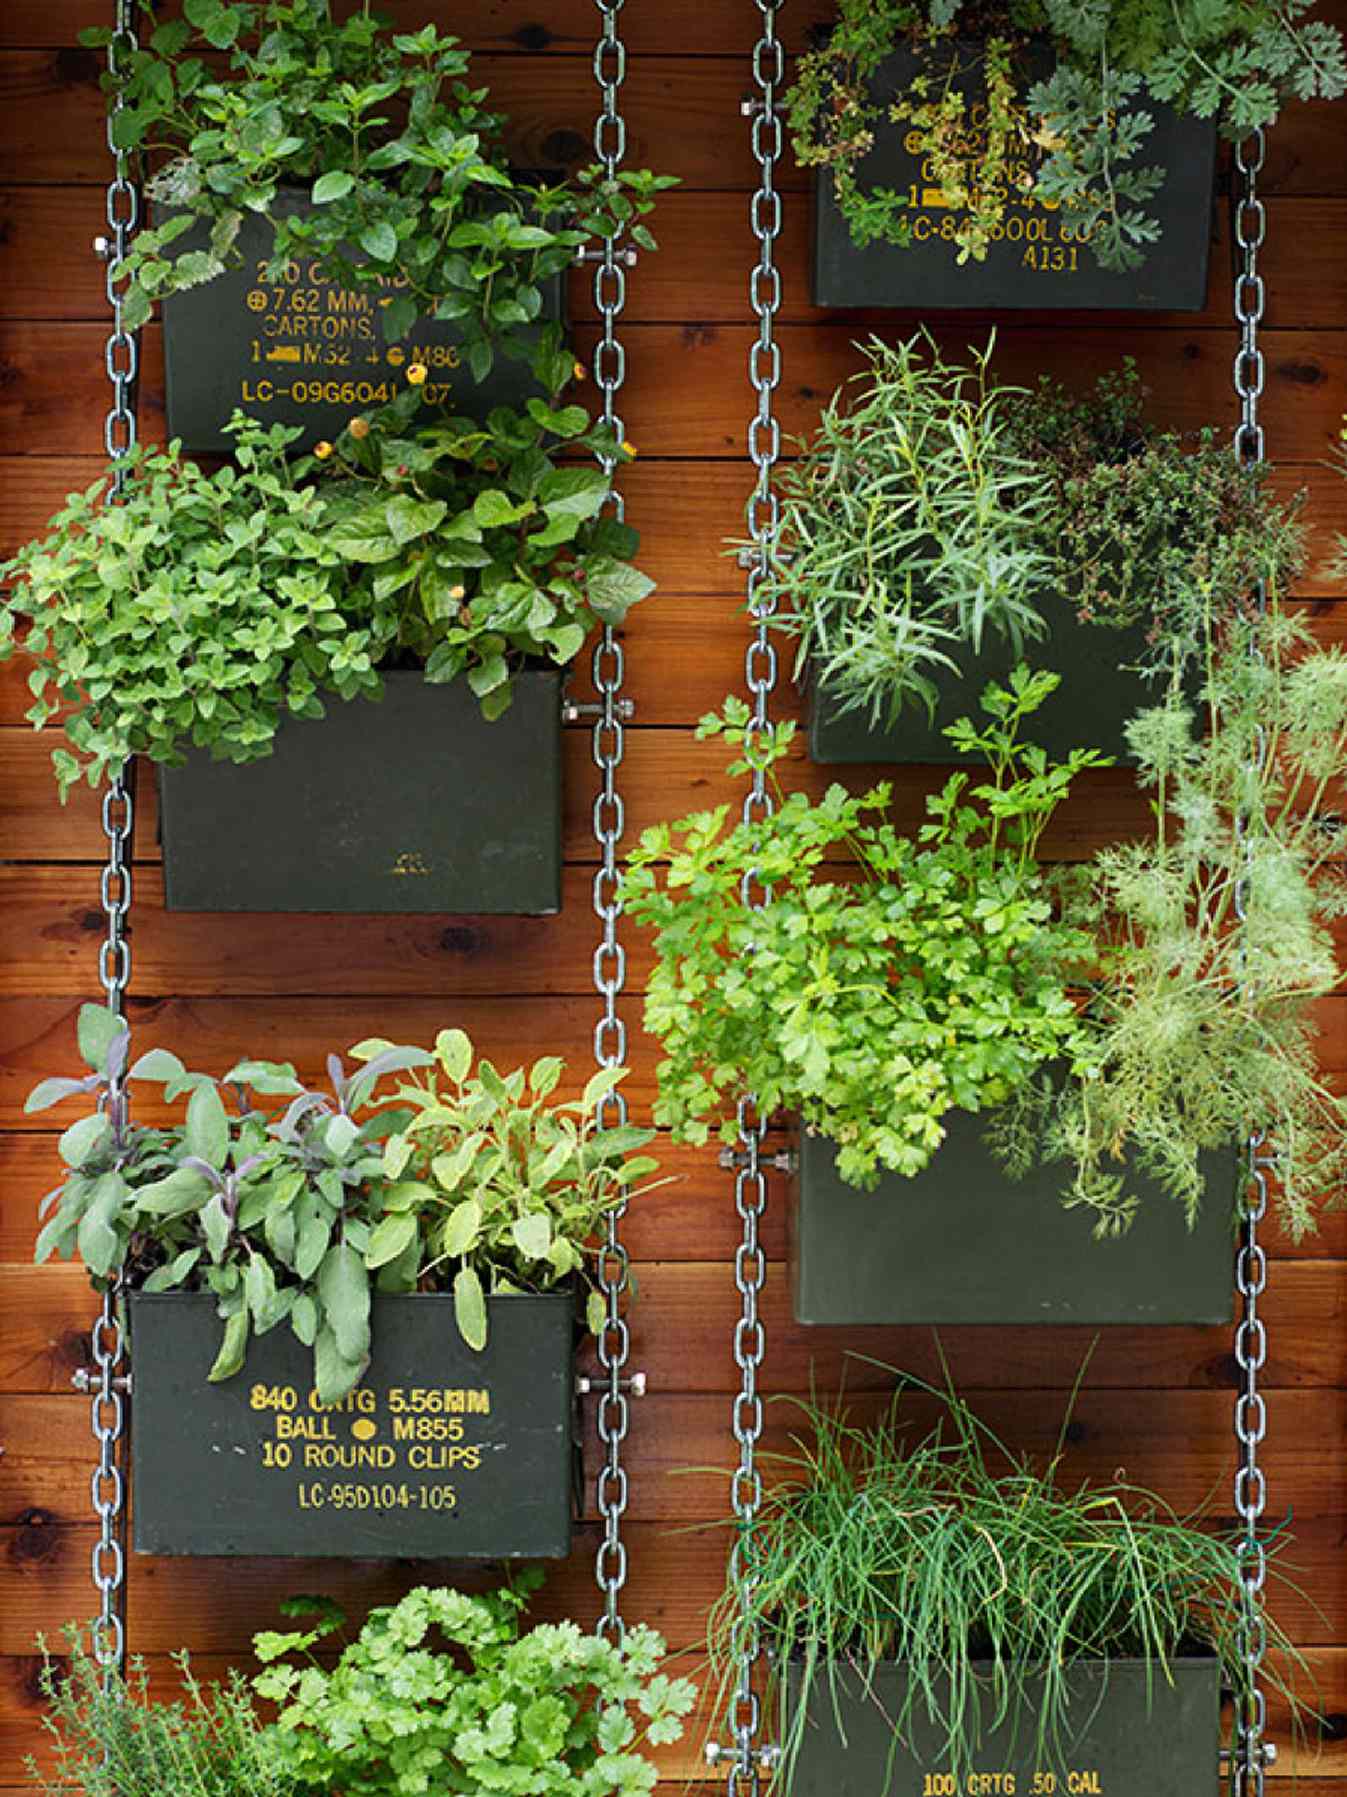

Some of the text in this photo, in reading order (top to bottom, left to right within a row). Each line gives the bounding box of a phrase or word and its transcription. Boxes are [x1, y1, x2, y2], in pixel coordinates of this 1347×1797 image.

[1023, 244, 1079, 272] A131
[256, 260, 301, 285] 20
[272, 288, 320, 312] 7.62
[251, 340, 261, 363] 1
[250, 1384, 297, 1412] 840
[276, 1415, 464, 1441] BALL M855
[262, 1443, 482, 1470] 10 ROUND CLIPS
[299, 1482, 457, 1510] LC-95D104-105
[923, 1774, 955, 1797] 100
[967, 1772, 1015, 1795] CRTG
[1066, 1770, 1102, 1794] CAL
